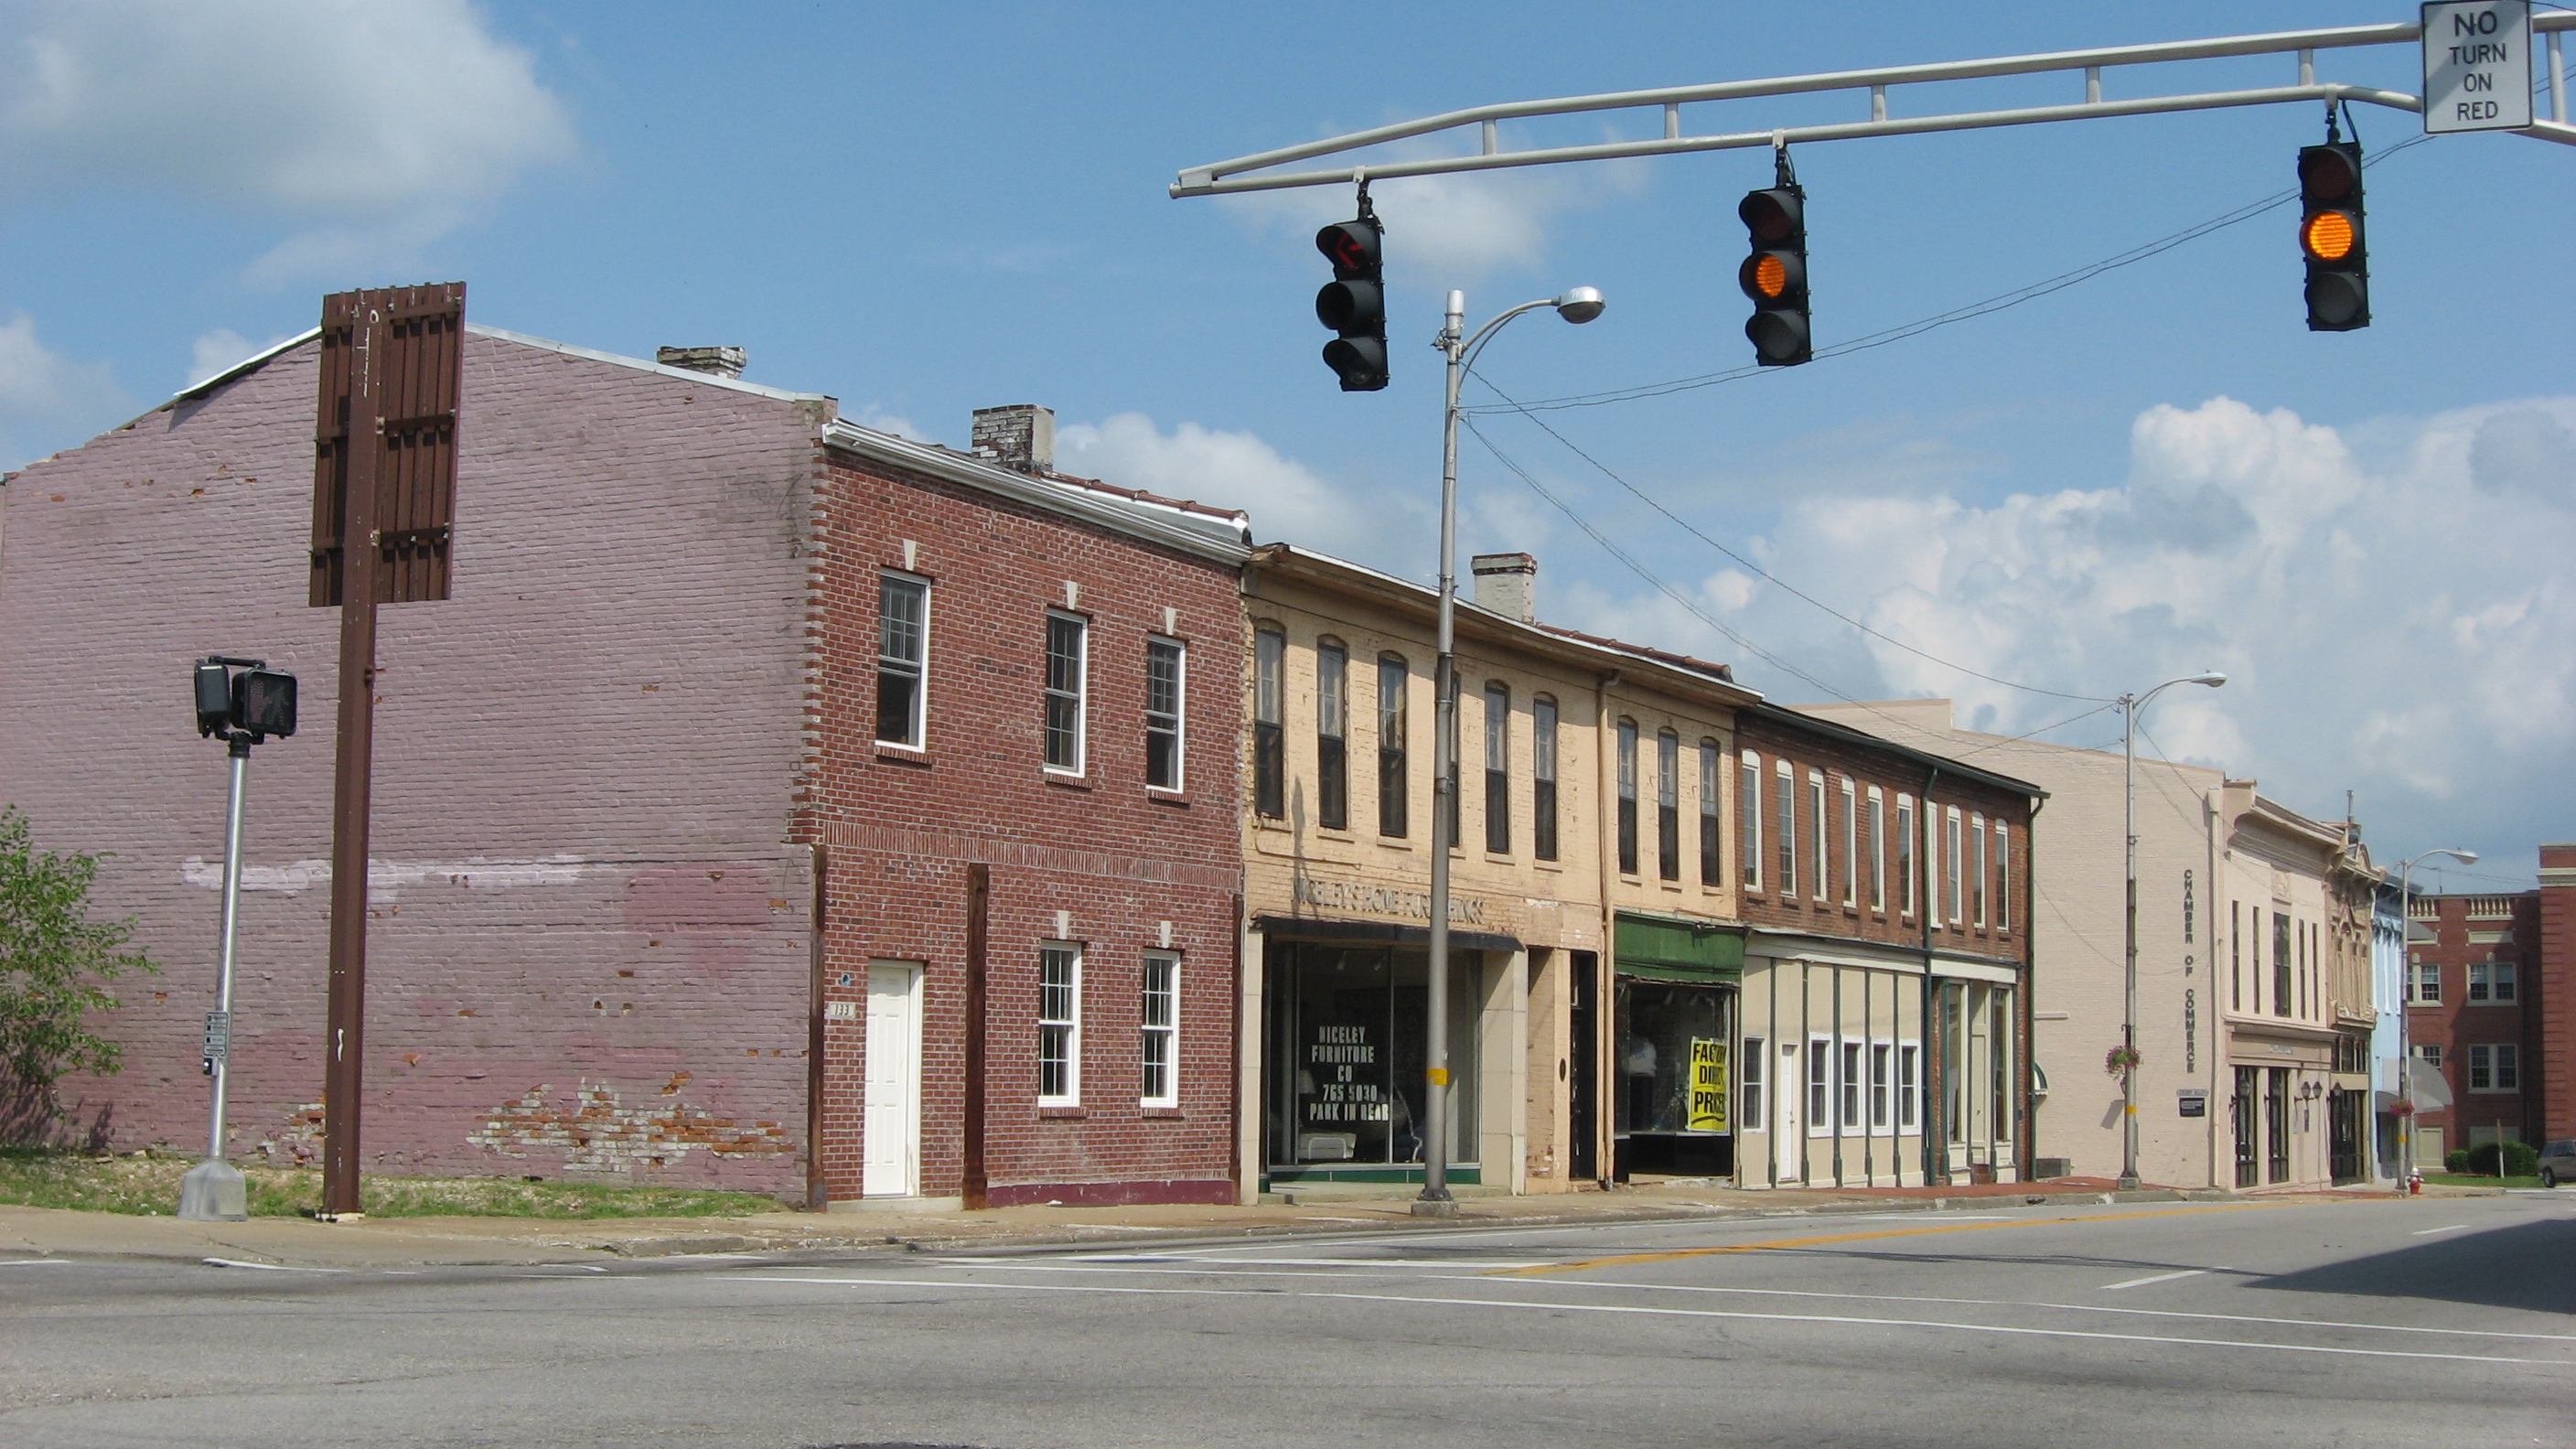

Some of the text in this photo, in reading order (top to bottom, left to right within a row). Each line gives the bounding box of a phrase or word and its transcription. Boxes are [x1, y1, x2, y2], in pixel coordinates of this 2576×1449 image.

[2453, 10, 2497, 37] NO
[2449, 43, 2506, 65] TURN
[2463, 72, 2492, 91] ON
[2457, 101, 2498, 122] RED
[1361, 885, 1401, 915] HOME
[2184, 868, 2195, 1074] CHAMBER OF COMMERCE
[834, 1003, 850, 1016] 133
[1318, 1025, 1366, 1044] NICELEY
[1311, 1045, 1375, 1063] FURNITURE
[1337, 1065, 1353, 1082] CO
[1323, 1084, 1378, 1102] 765 5030
[1309, 1103, 1390, 1121] PARK IN REAR
